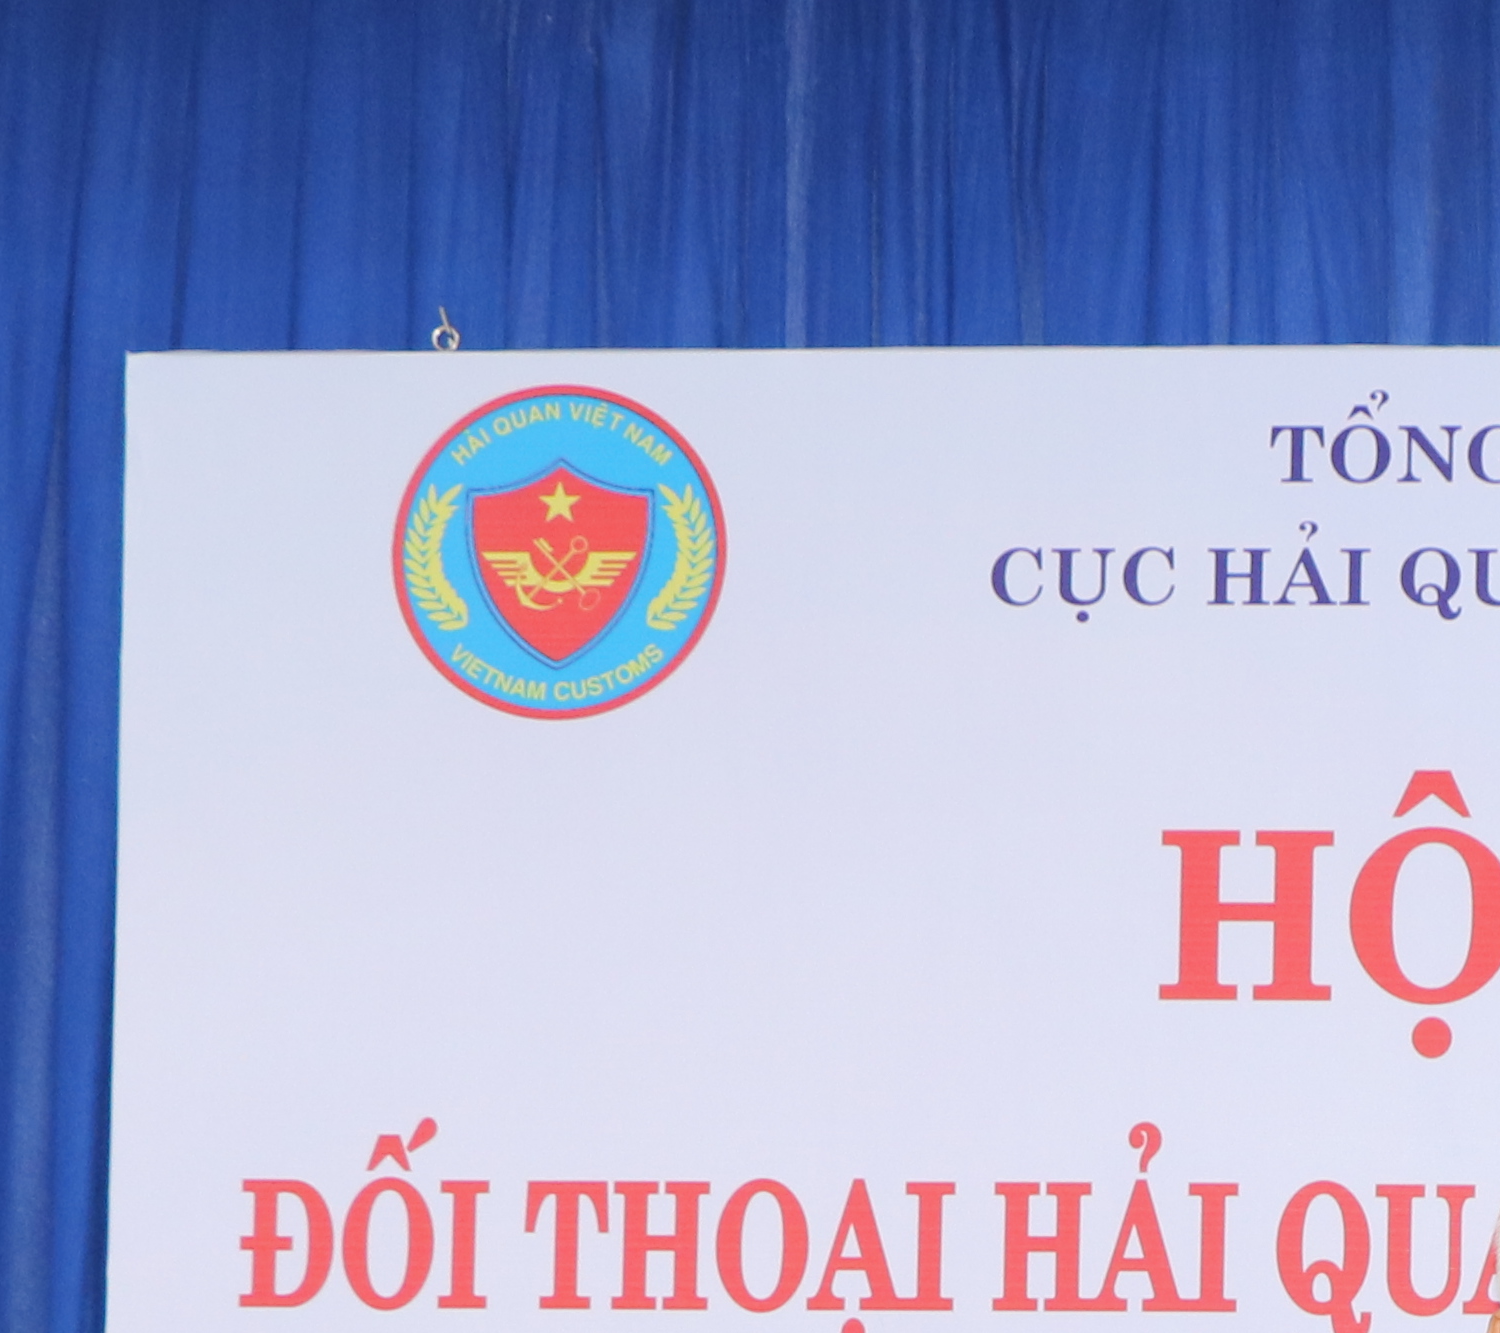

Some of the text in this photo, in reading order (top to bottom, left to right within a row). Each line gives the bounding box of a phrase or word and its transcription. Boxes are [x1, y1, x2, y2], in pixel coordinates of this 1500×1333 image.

[450, 402, 674, 466] HẢI QUAN VIỆT NAM
[991, 547, 1174, 623] CỤC
[1207, 523, 1370, 607] HẢI
[450, 641, 665, 702] VIETNAM CUSTOMS
[239, 1118, 489, 1311] ĐỐI
[993, 1122, 1239, 1313] HẢI
